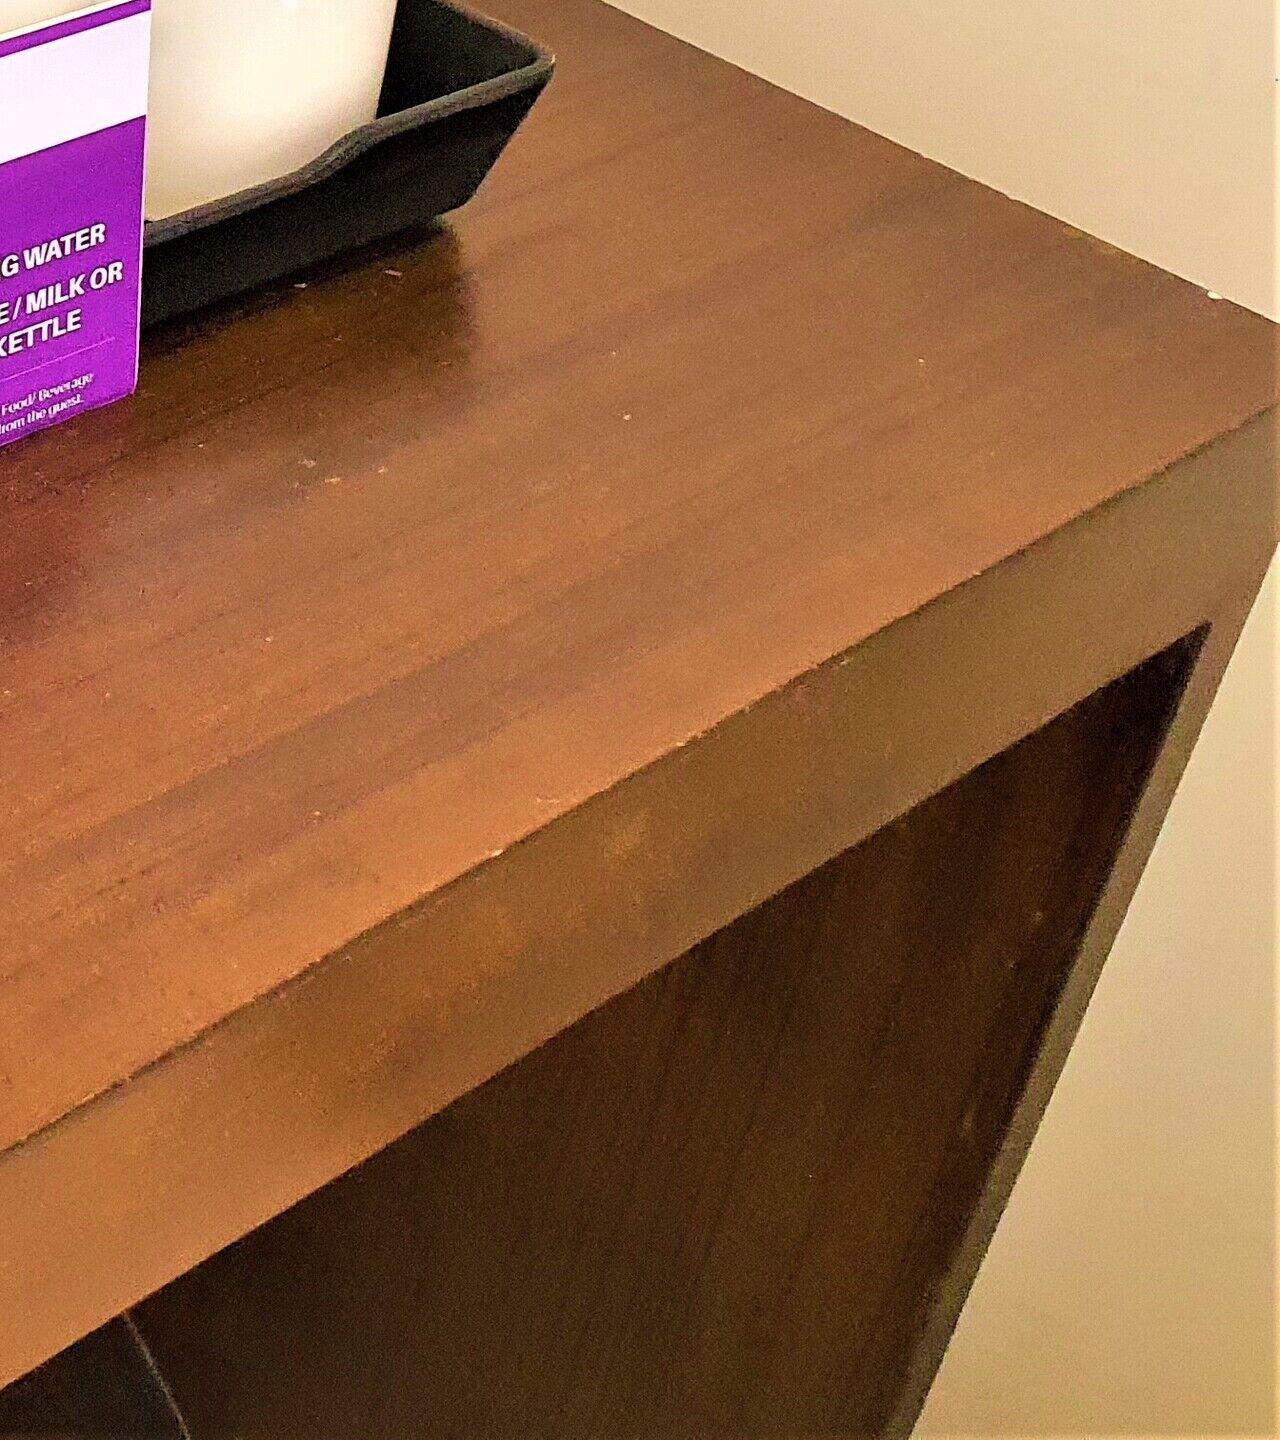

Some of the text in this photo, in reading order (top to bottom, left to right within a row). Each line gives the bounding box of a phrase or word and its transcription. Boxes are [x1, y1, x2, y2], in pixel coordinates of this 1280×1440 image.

[22, 223, 107, 270] WATER
[13, 297, 23, 320] /
[25, 277, 86, 316] MILK
[89, 261, 124, 290] OR
[38, 373, 95, 403] Beverage
[27, 406, 47, 424] the
